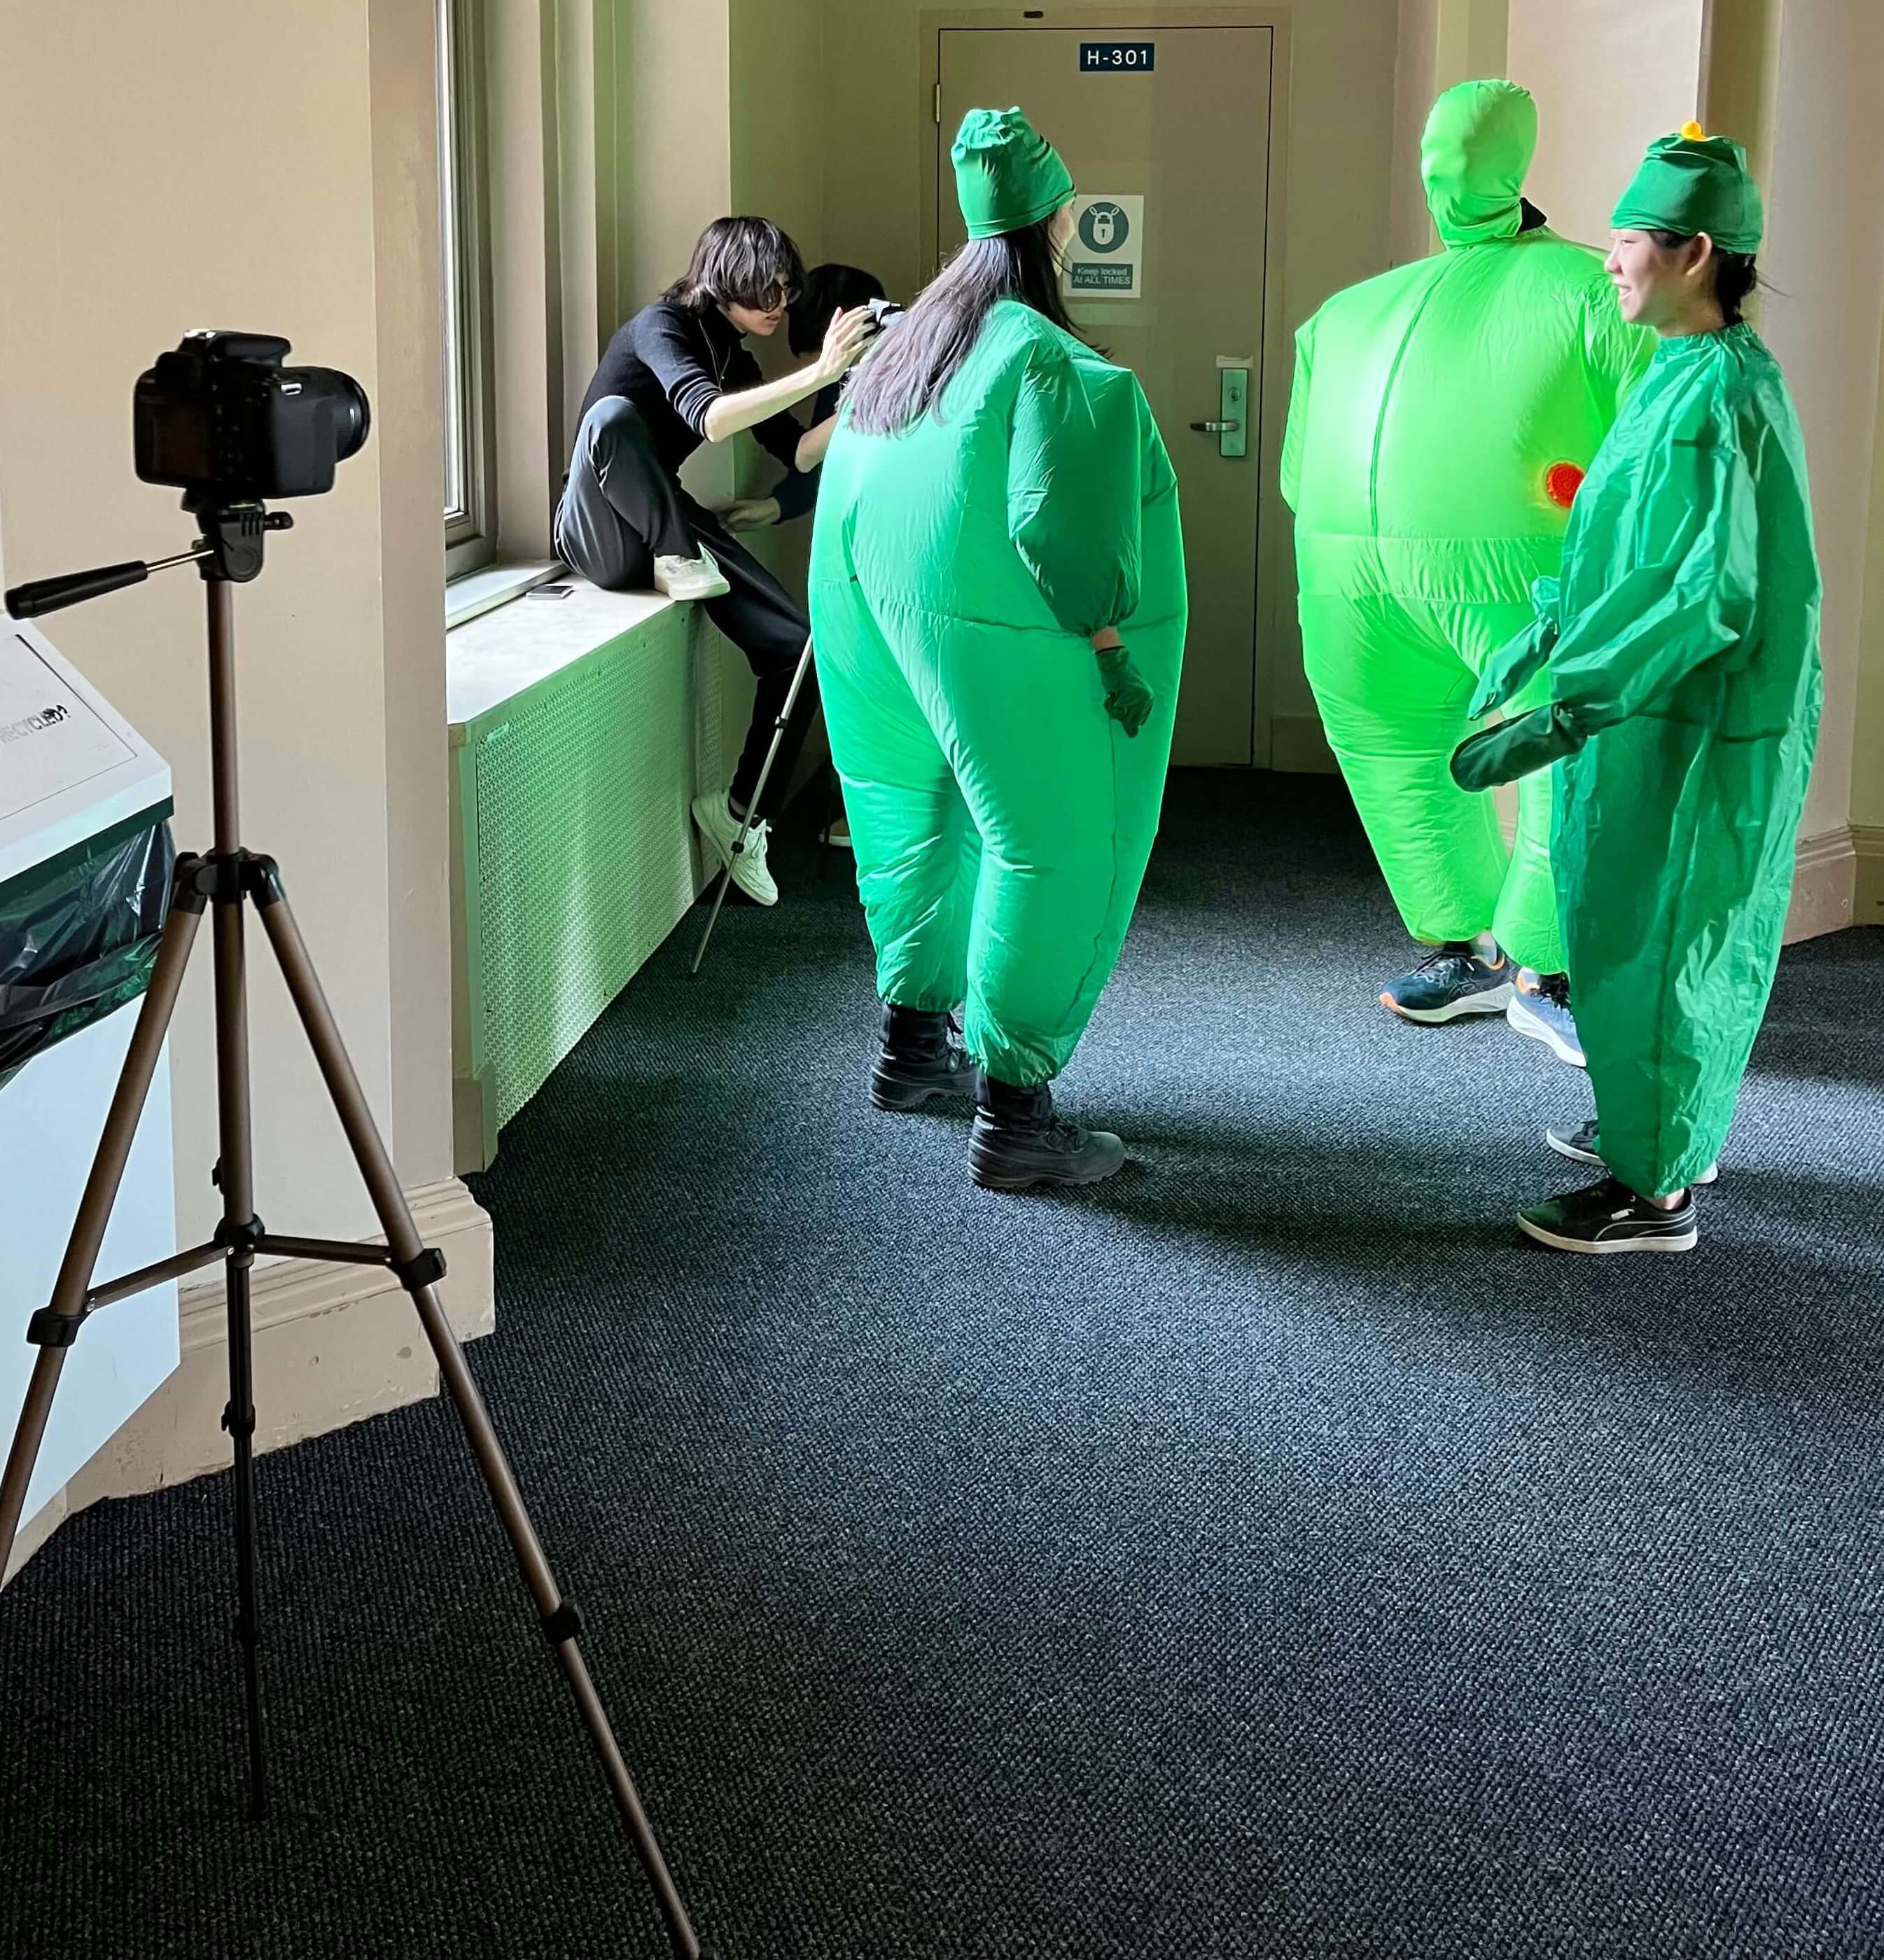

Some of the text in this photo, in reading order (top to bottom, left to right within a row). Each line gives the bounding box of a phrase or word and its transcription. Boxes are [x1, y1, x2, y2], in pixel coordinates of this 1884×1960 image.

[1087, 50, 1146, 64] H-301
[1077, 267, 1099, 276] Keep
[1084, 276, 1101, 284] ALL
[1103, 276, 1131, 285] TIMES
